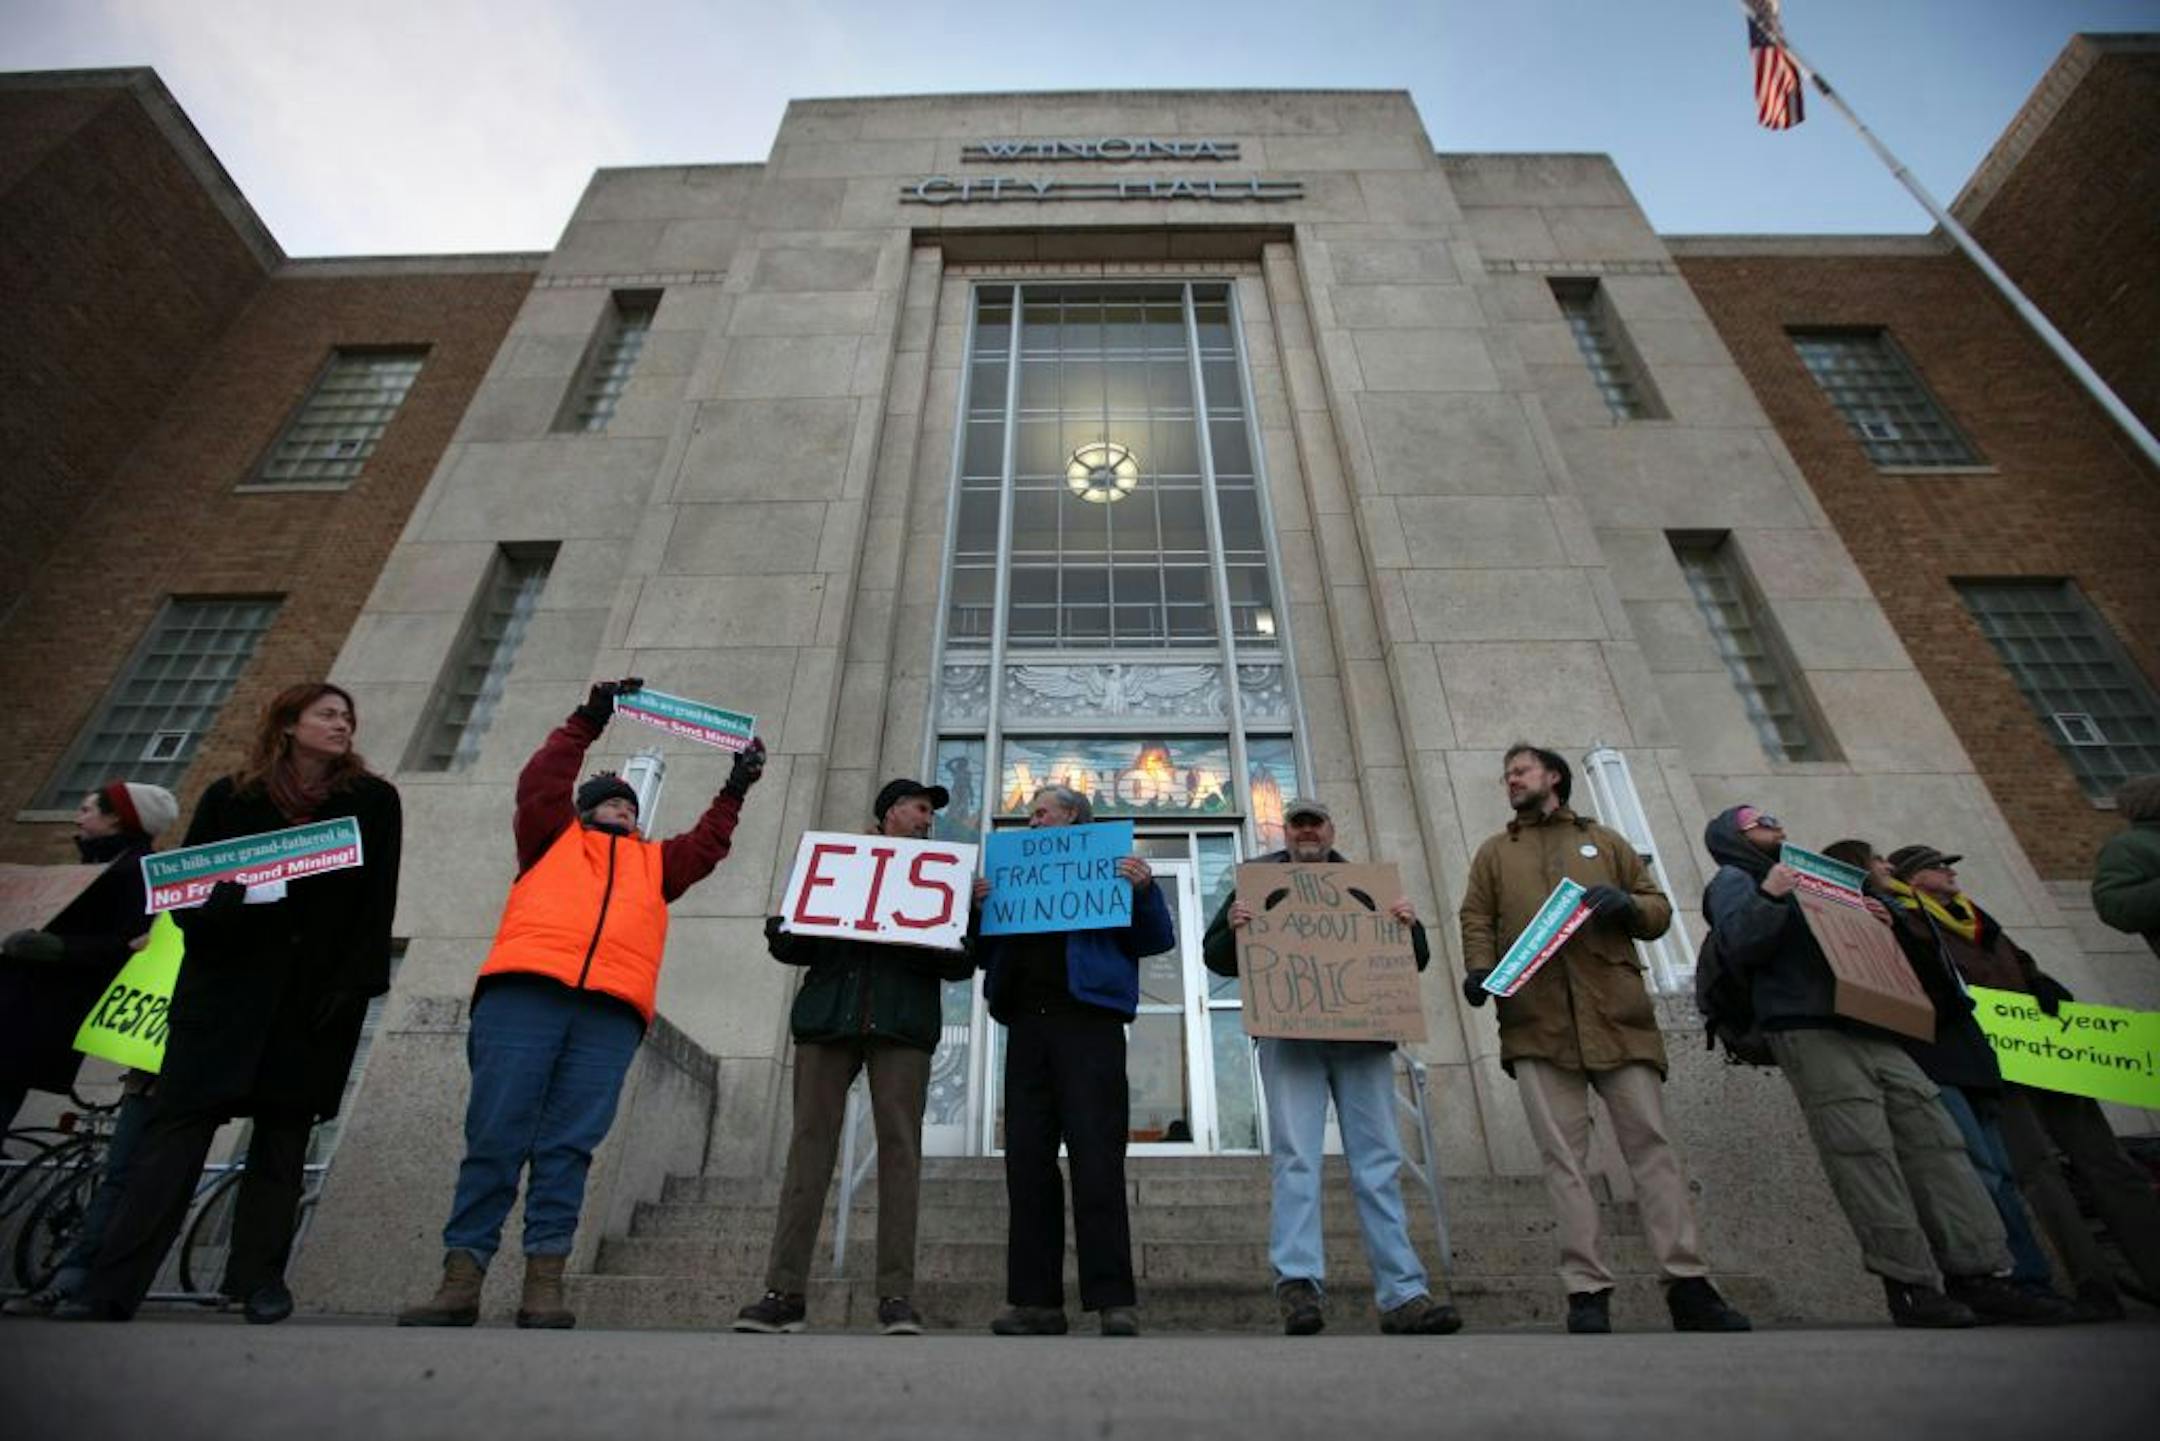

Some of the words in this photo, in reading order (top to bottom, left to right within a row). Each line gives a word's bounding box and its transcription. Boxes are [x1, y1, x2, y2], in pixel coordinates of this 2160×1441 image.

[982, 138, 1223, 159] WINONA
[917, 175, 1057, 204] CITY
[1118, 175, 1271, 197] HALL
[151, 859, 180, 877] The
[181, 854, 213, 871] hills
[214, 849, 237, 863] are
[154, 889, 182, 906] No
[235, 865, 282, 886] Sand
[288, 848, 355, 875] Mining!
[995, 856, 1127, 889] FRACTURE
[1284, 868, 1343, 907] THIS
[1248, 914, 1270, 936] IS
[1281, 912, 1361, 943] ABOUT
[1245, 943, 1369, 1022] PUBLIC
[1994, 1003, 2041, 1021] one
[2058, 1014, 2130, 1034] year
